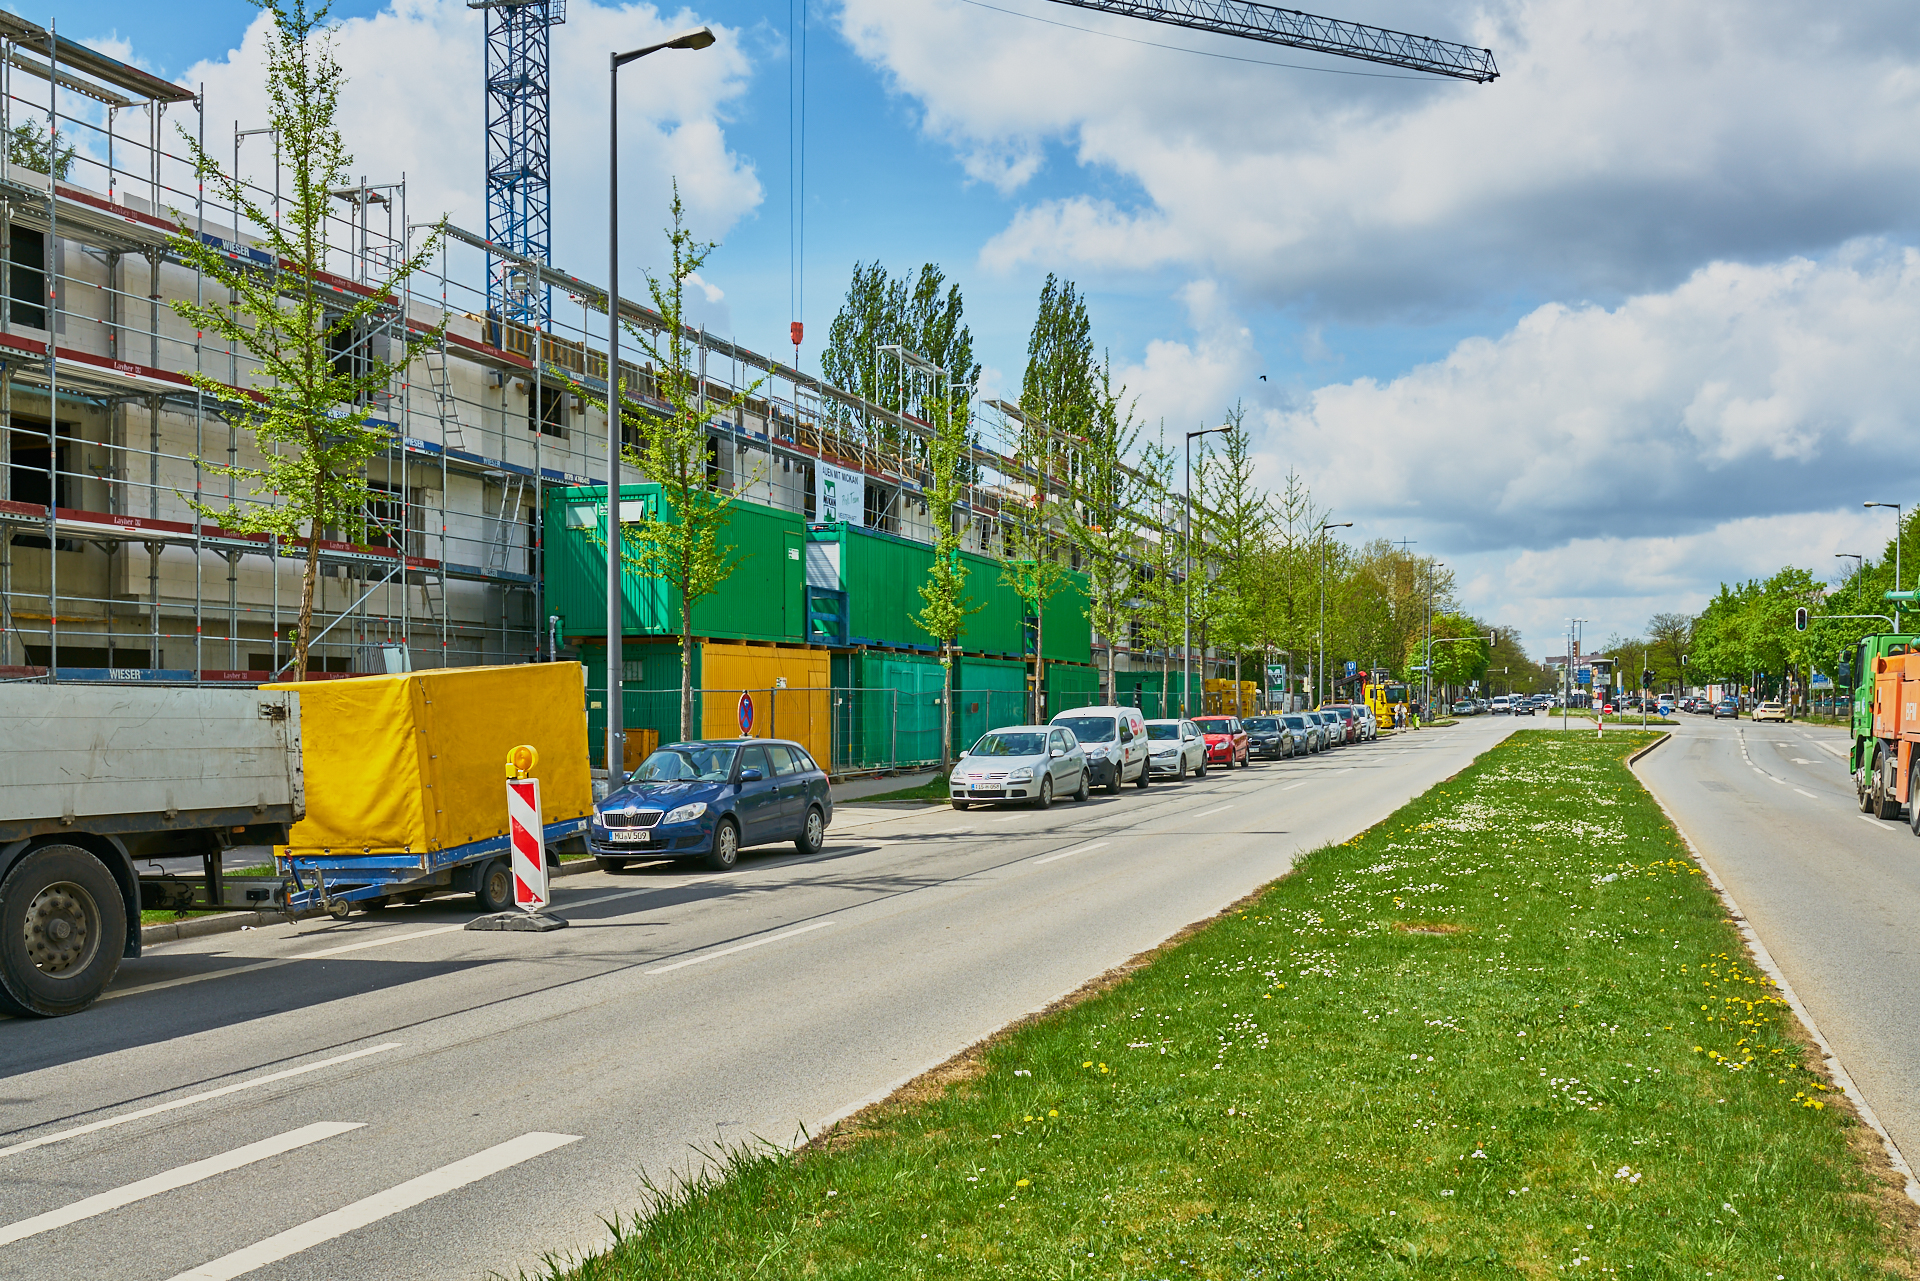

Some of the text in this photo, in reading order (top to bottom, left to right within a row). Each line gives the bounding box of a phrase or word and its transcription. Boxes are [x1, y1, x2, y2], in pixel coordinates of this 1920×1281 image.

[222, 239, 250, 257] WIESER
[114, 361, 134, 373] Layher
[404, 437, 425, 449] WIESER
[483, 457, 501, 468] WIESER
[114, 516, 134, 526] Layher
[109, 669, 141, 680] WIESER
[223, 672, 241, 680] Layher
[633, 832, 647, 840] 509
